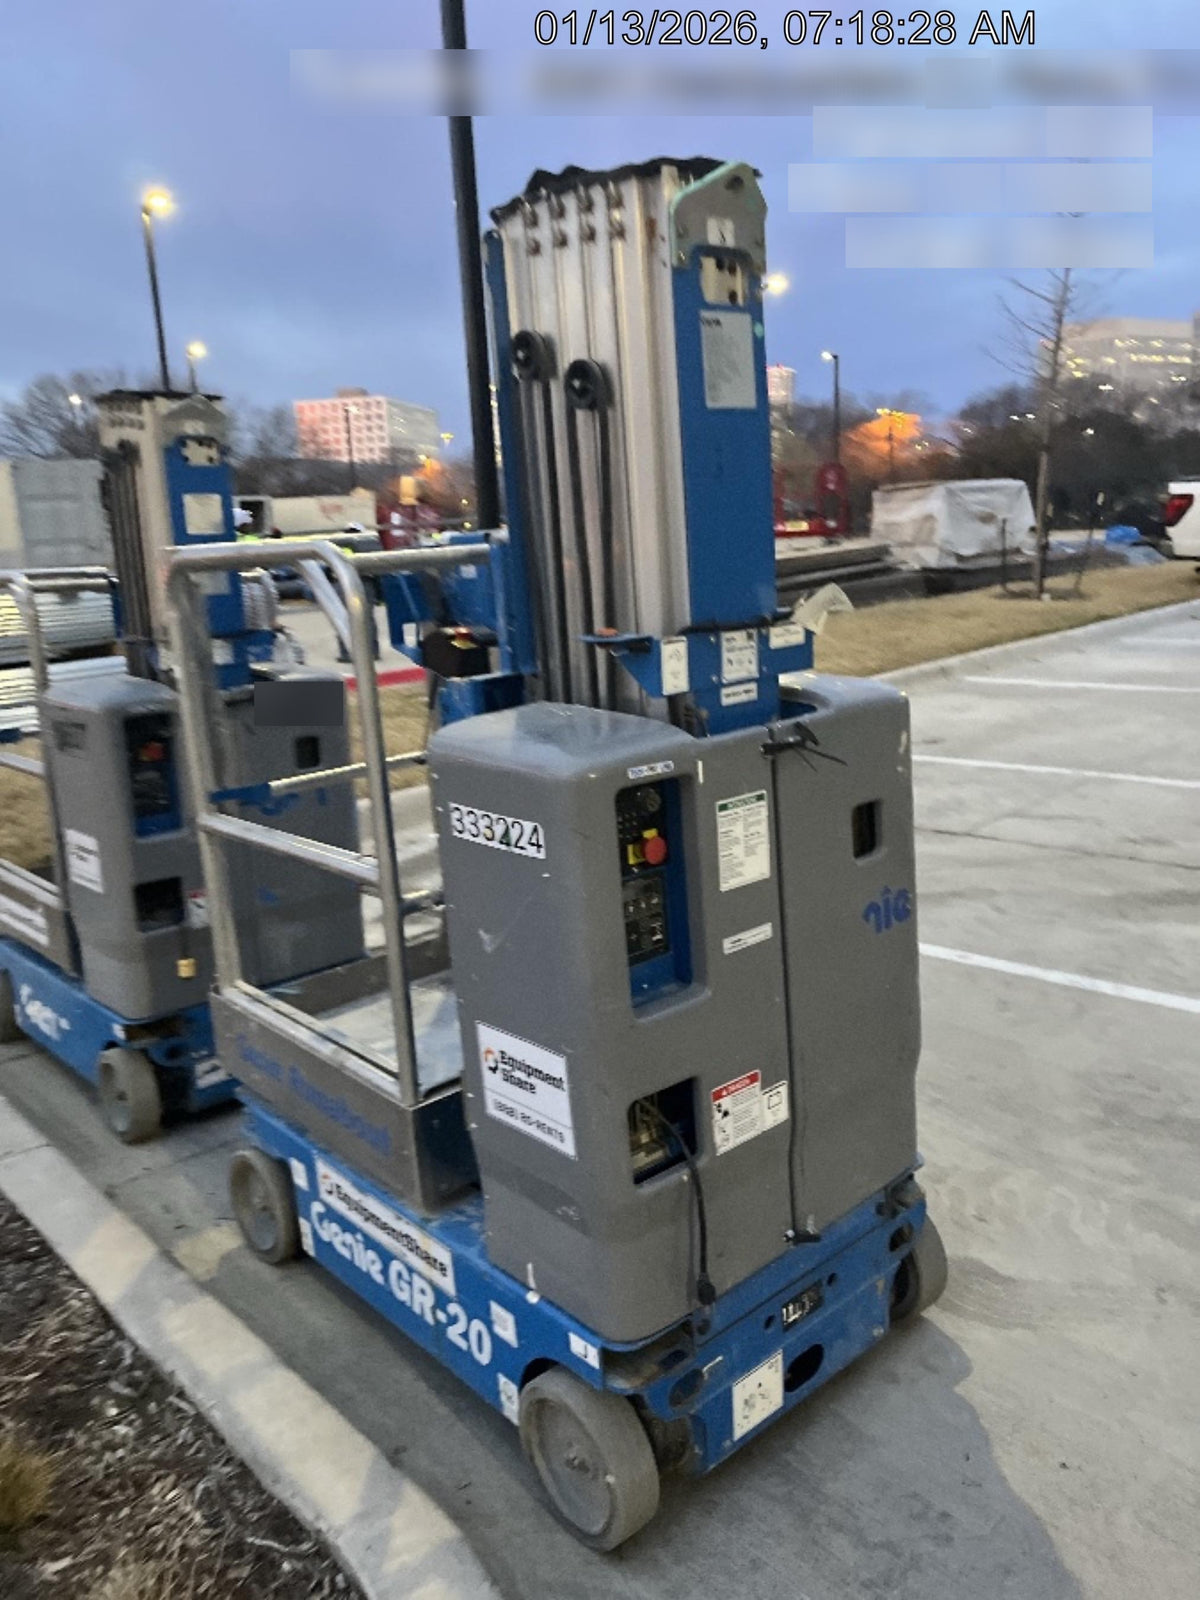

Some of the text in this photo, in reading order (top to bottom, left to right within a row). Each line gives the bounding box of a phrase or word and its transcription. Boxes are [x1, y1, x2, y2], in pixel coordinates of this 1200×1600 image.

[451, 806, 543, 853] 333224
[499, 1050, 566, 1092] Equipment
[311, 1201, 385, 1285] Genie
[389, 1259, 492, 1366] GR-20
